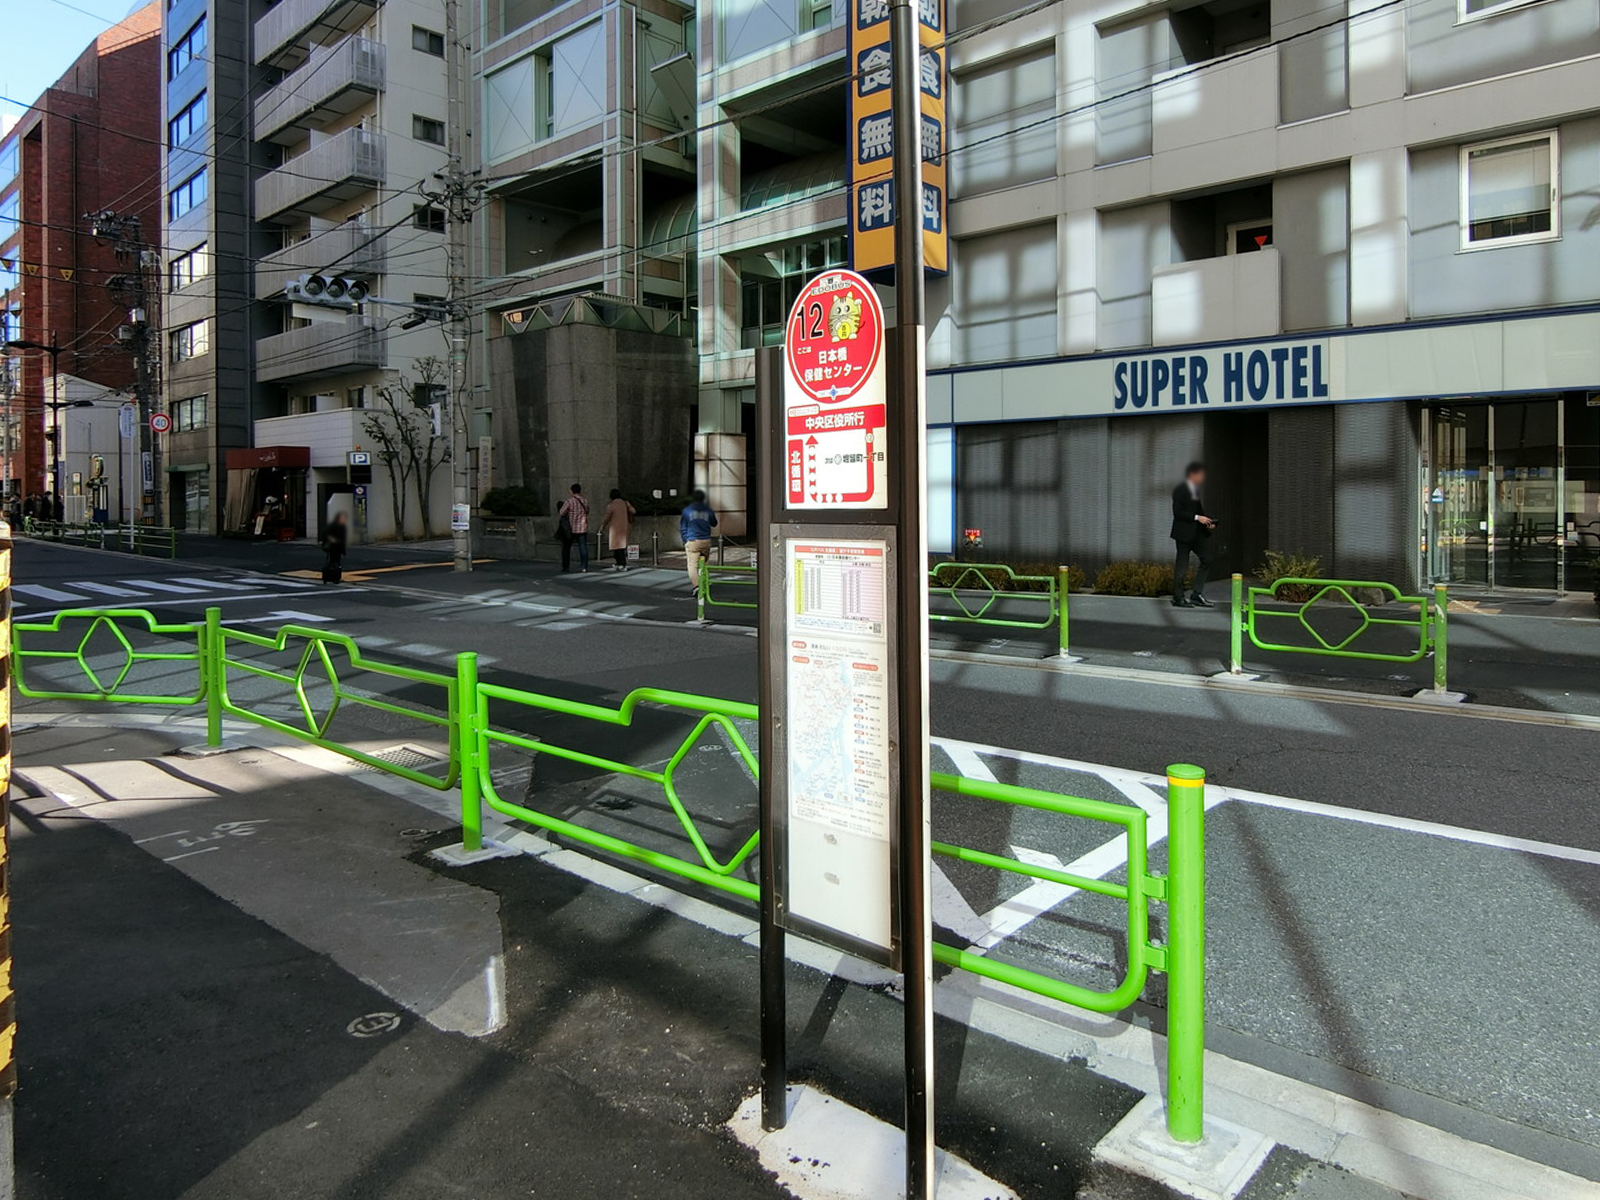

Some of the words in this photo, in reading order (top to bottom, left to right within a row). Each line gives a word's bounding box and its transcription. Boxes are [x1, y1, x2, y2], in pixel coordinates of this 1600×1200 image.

[796, 302, 824, 341] 12
[818, 347, 848, 364] 日本橋
[804, 363, 863, 382] 保健センター
[1115, 355, 1209, 410] SUPER
[1223, 344, 1328, 402] HOTEL
[155, 418, 167, 428] 40
[805, 411, 866, 431] 中央区役所行
[355, 453, 366, 464] P
